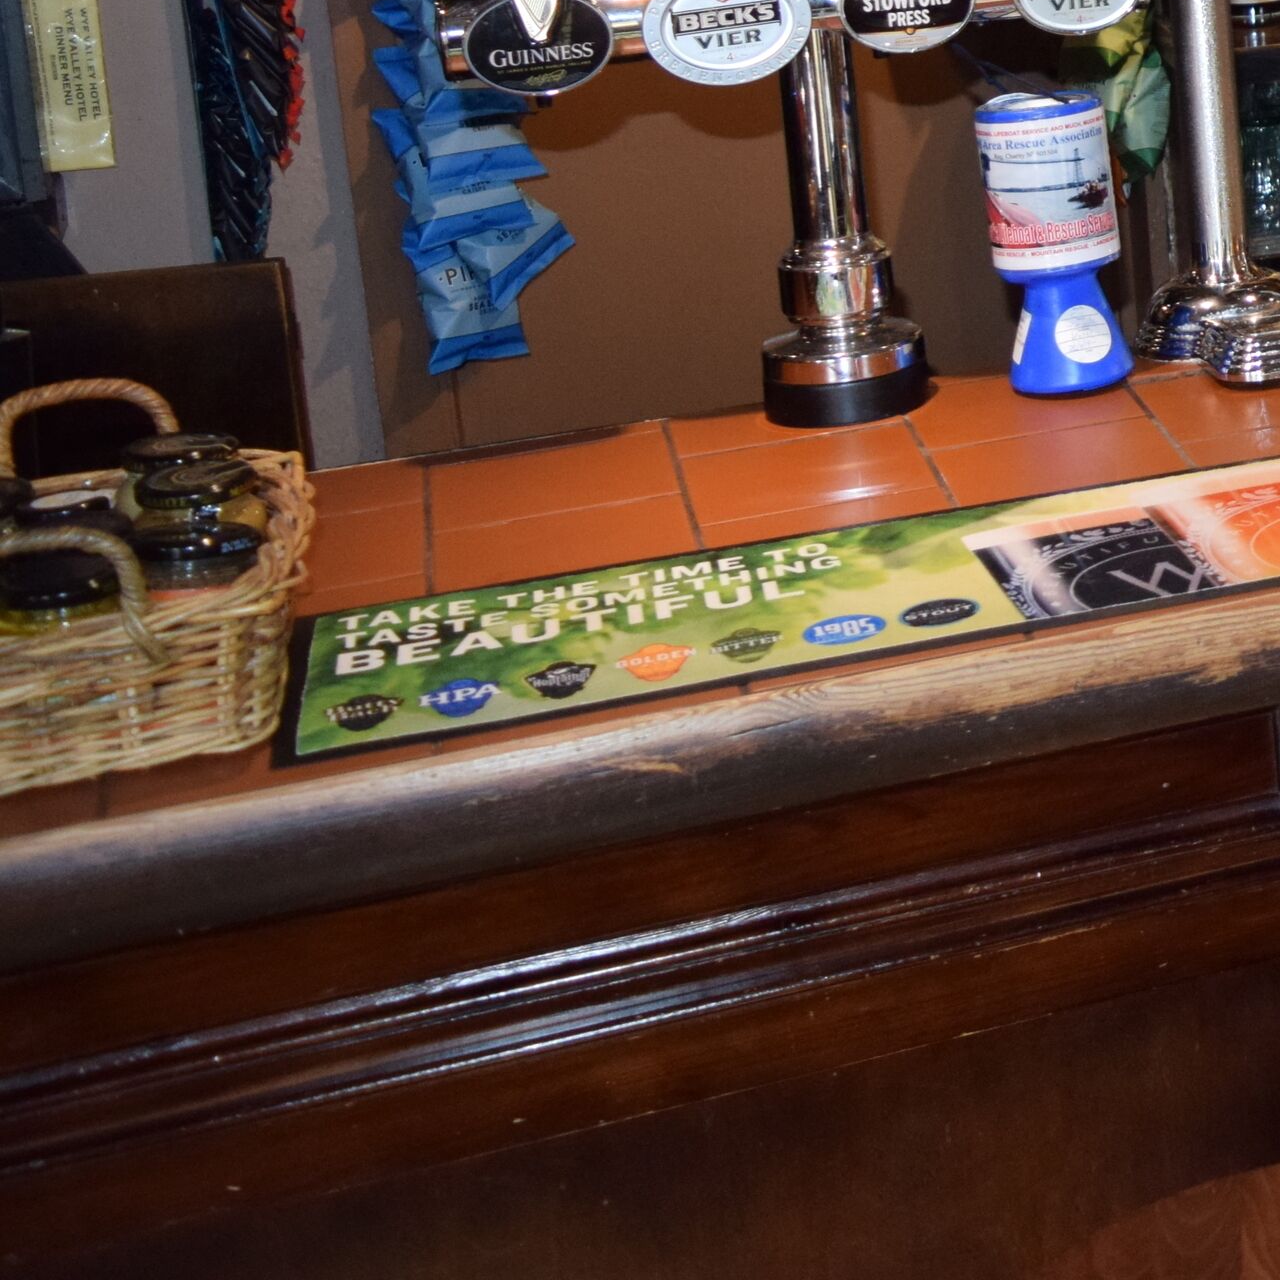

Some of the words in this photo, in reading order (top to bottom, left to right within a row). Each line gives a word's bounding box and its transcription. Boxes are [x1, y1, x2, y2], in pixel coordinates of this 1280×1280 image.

[677, 1, 777, 33] BECK'S
[887, 8, 931, 30] PRESS
[54, 25, 69, 72] DINNER
[693, 28, 763, 50] VIER
[488, 41, 595, 68] GUINNESS
[61, 72, 73, 107] MENU
[74, 82, 88, 122] HOTEL
[89, 80, 102, 120] HOTEL
[982, 140, 1002, 151] Area
[1005, 138, 1046, 151] Rescue
[1051, 126, 1103, 146] Association
[1050, 125, 1064, 133] AND
[1036, 225, 1045, 243] &
[1045, 219, 1087, 243] Rescue
[336, 597, 477, 631] TAKE
[496, 579, 601, 609] THE
[618, 554, 745, 587] TIME
[760, 541, 828, 563] TO
[333, 614, 511, 649] TASTE
[528, 554, 842, 620] SOMETHING
[902, 602, 974, 624] STOUT
[332, 577, 807, 677] BEAUTIFUL
[811, 617, 875, 639] 1985
[615, 644, 698, 671] GOLDEN
[708, 632, 785, 657] BITTER
[417, 680, 502, 710] HPA
